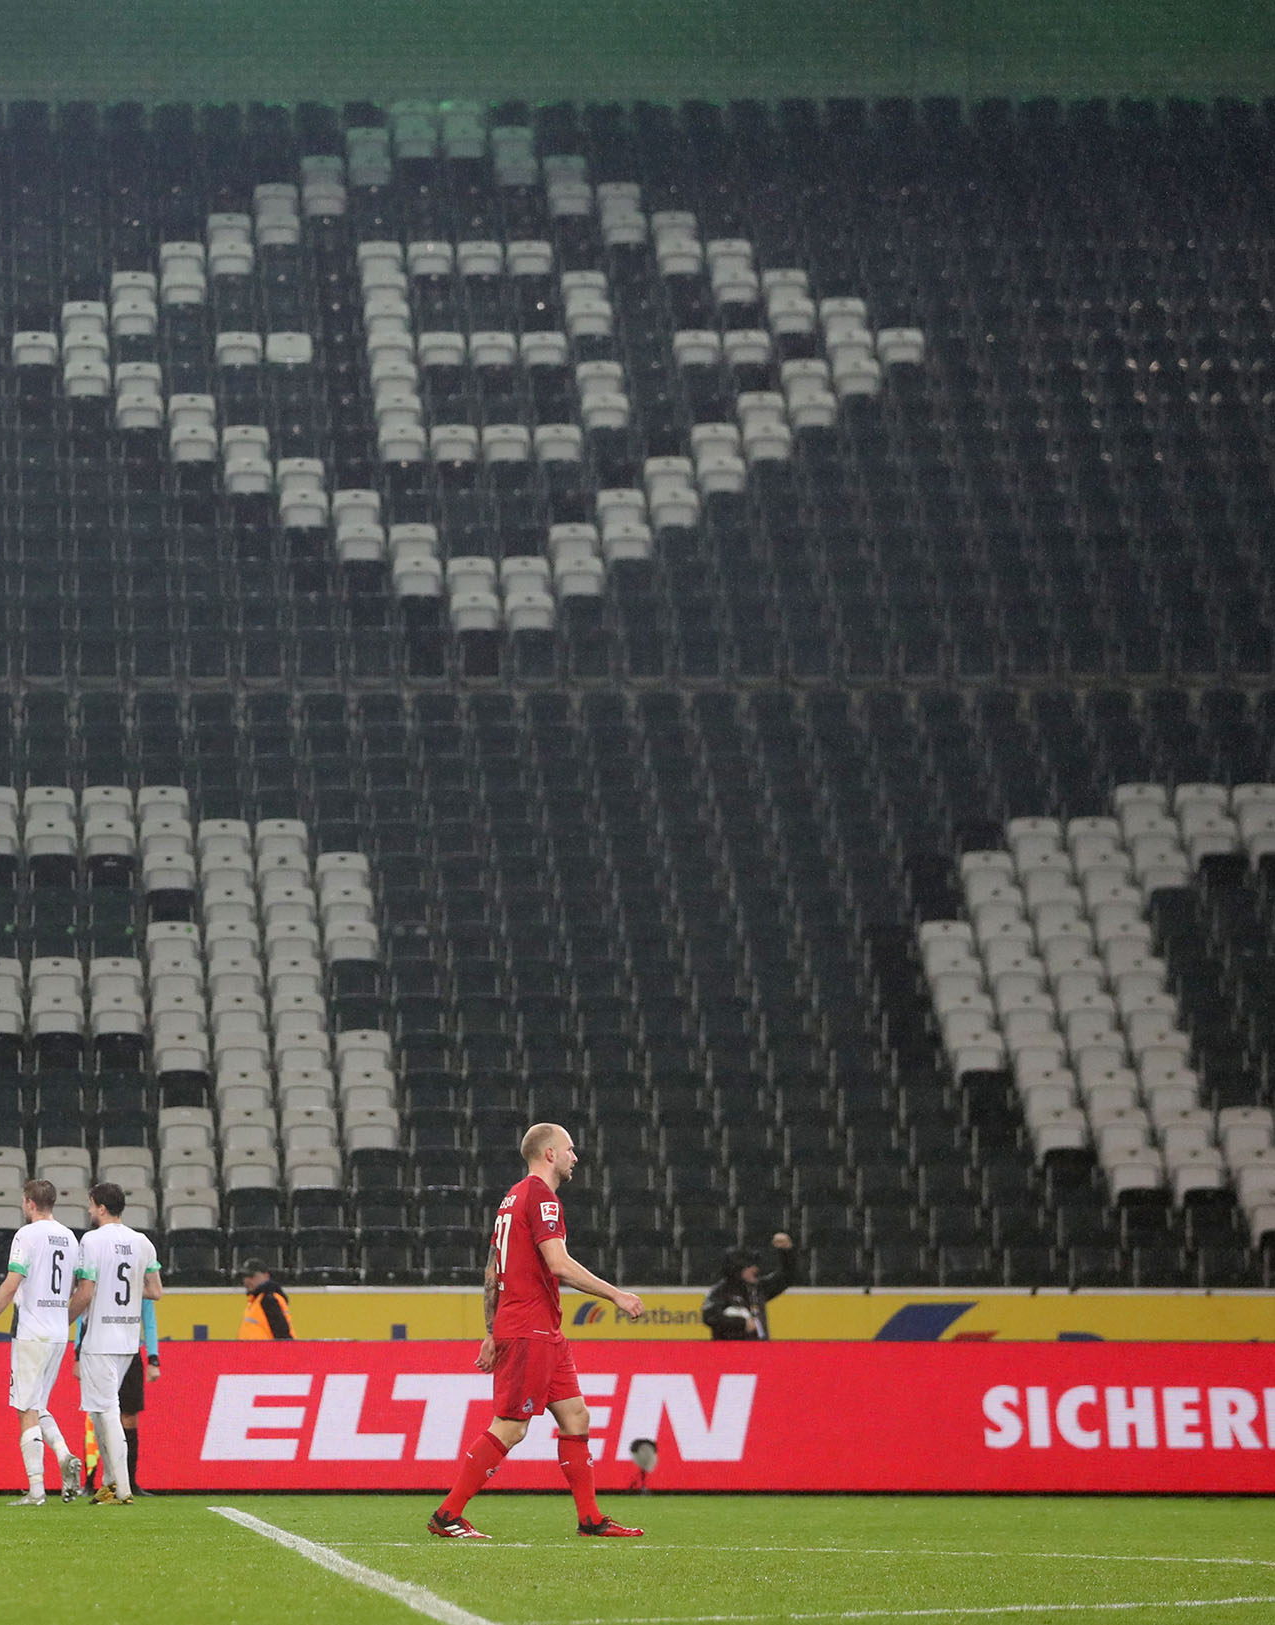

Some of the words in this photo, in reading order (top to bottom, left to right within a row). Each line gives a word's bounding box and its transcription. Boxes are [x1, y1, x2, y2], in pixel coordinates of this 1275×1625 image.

[51, 1249, 65, 1295] 6
[114, 1262, 131, 1306] 5
[614, 1305, 704, 1326] Pstban
[199, 1373, 757, 1462] ELTEN
[981, 1384, 1275, 1450] SICHER
